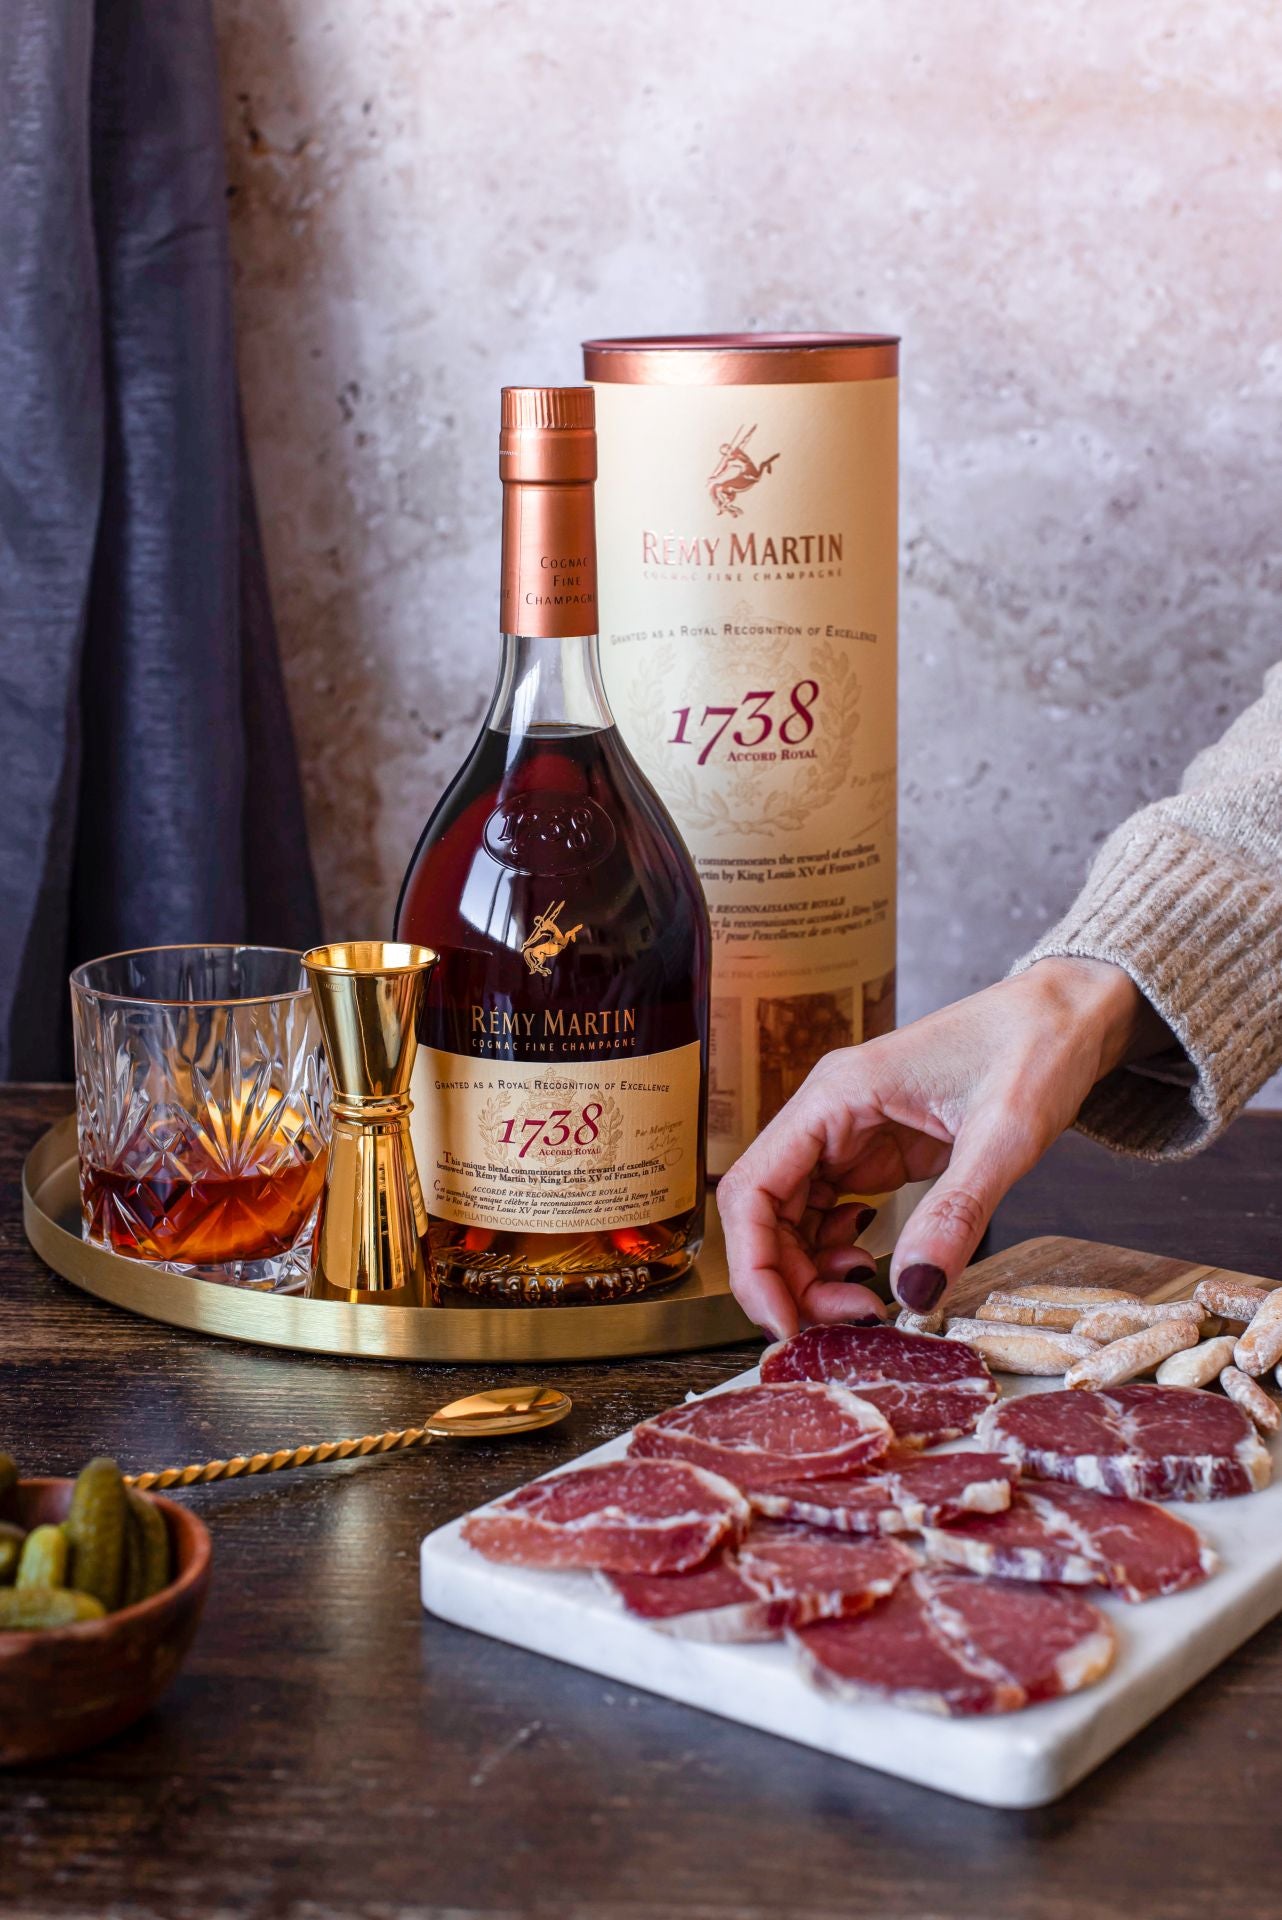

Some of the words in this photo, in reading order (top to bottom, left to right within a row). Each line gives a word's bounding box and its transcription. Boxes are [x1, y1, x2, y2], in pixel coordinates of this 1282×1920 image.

[643, 530, 720, 566] RÉMY
[728, 532, 843, 566] MARTIN
[540, 556, 588, 568] COGNAC
[554, 574, 582, 587] FINE
[707, 572, 743, 582] FINE
[753, 568, 843, 582] CHAMPAGNE
[652, 629, 664, 638] AS
[668, 628, 675, 637] A
[680, 625, 718, 637] ROYAL
[724, 624, 802, 637] RECOGNITION
[808, 626, 820, 636] OF
[826, 625, 878, 644] EXCELLENCE
[667, 679, 820, 766] 1738
[727, 750, 777, 762] ACCORD
[780, 748, 818, 761] ROYAL
[698, 858, 776, 866] commemorates
[779, 854, 794, 864] the
[797, 849, 830, 863] reward
[832, 848, 841, 859] of
[722, 870, 734, 884] by
[737, 870, 765, 883] King
[768, 869, 796, 879] Louis
[798, 866, 816, 878] XV
[817, 864, 827, 876] of
[472, 1005, 536, 1036] RÉMY
[544, 1008, 636, 1036] MARTIN
[472, 1038, 518, 1050] COGNAC
[526, 1042, 554, 1052] FINE
[562, 1038, 636, 1050] CHAMPAGNE
[434, 1080, 470, 1090] GRANTED
[498, 1080, 529, 1090] ROYAL
[534, 1080, 600, 1090] RECOGNITION
[604, 1082, 616, 1090] OF
[620, 1080, 670, 1092] EXCELLENCE
[498, 1102, 603, 1158] 1738
[575, 1148, 600, 1156] ROYAL
[443, 1151, 460, 1166] This
[462, 1162, 486, 1172] unique
[488, 1164, 509, 1174] blend
[511, 1168, 572, 1176] commemorates
[588, 1164, 616, 1174] reward
[618, 1163, 625, 1171] of
[626, 1159, 660, 1170] excellence
[476, 1170, 497, 1182] Rémy
[499, 1174, 526, 1184] Martin
[528, 1176, 538, 1186] by
[540, 1176, 562, 1186] King
[588, 1174, 602, 1182] XV
[604, 1172, 613, 1180] of
[614, 1170, 640, 1180] France,
[472, 1186, 507, 1196] ACCORDÉ
[526, 1190, 596, 1198] RECONNAISSANCE
[599, 1186, 628, 1196] ROYALE
[480, 1196, 502, 1205] unique
[504, 1197, 529, 1206] célèbre
[594, 1196, 624, 1205] accordée
[630, 1192, 649, 1201] Rémy
[452, 1196, 462, 1206] Roi
[464, 1199, 471, 1207] de
[472, 1201, 495, 1211] France
[496, 1204, 516, 1214] Louis
[532, 1208, 550, 1216] pour
[454, 1210, 498, 1224] APPELLATION
[500, 1217, 535, 1228] COGNAC
[536, 1220, 554, 1228] FINE
[556, 1217, 606, 1228] CHAMPAGNE
[608, 1209, 650, 1224] CONTRÔLÉE
